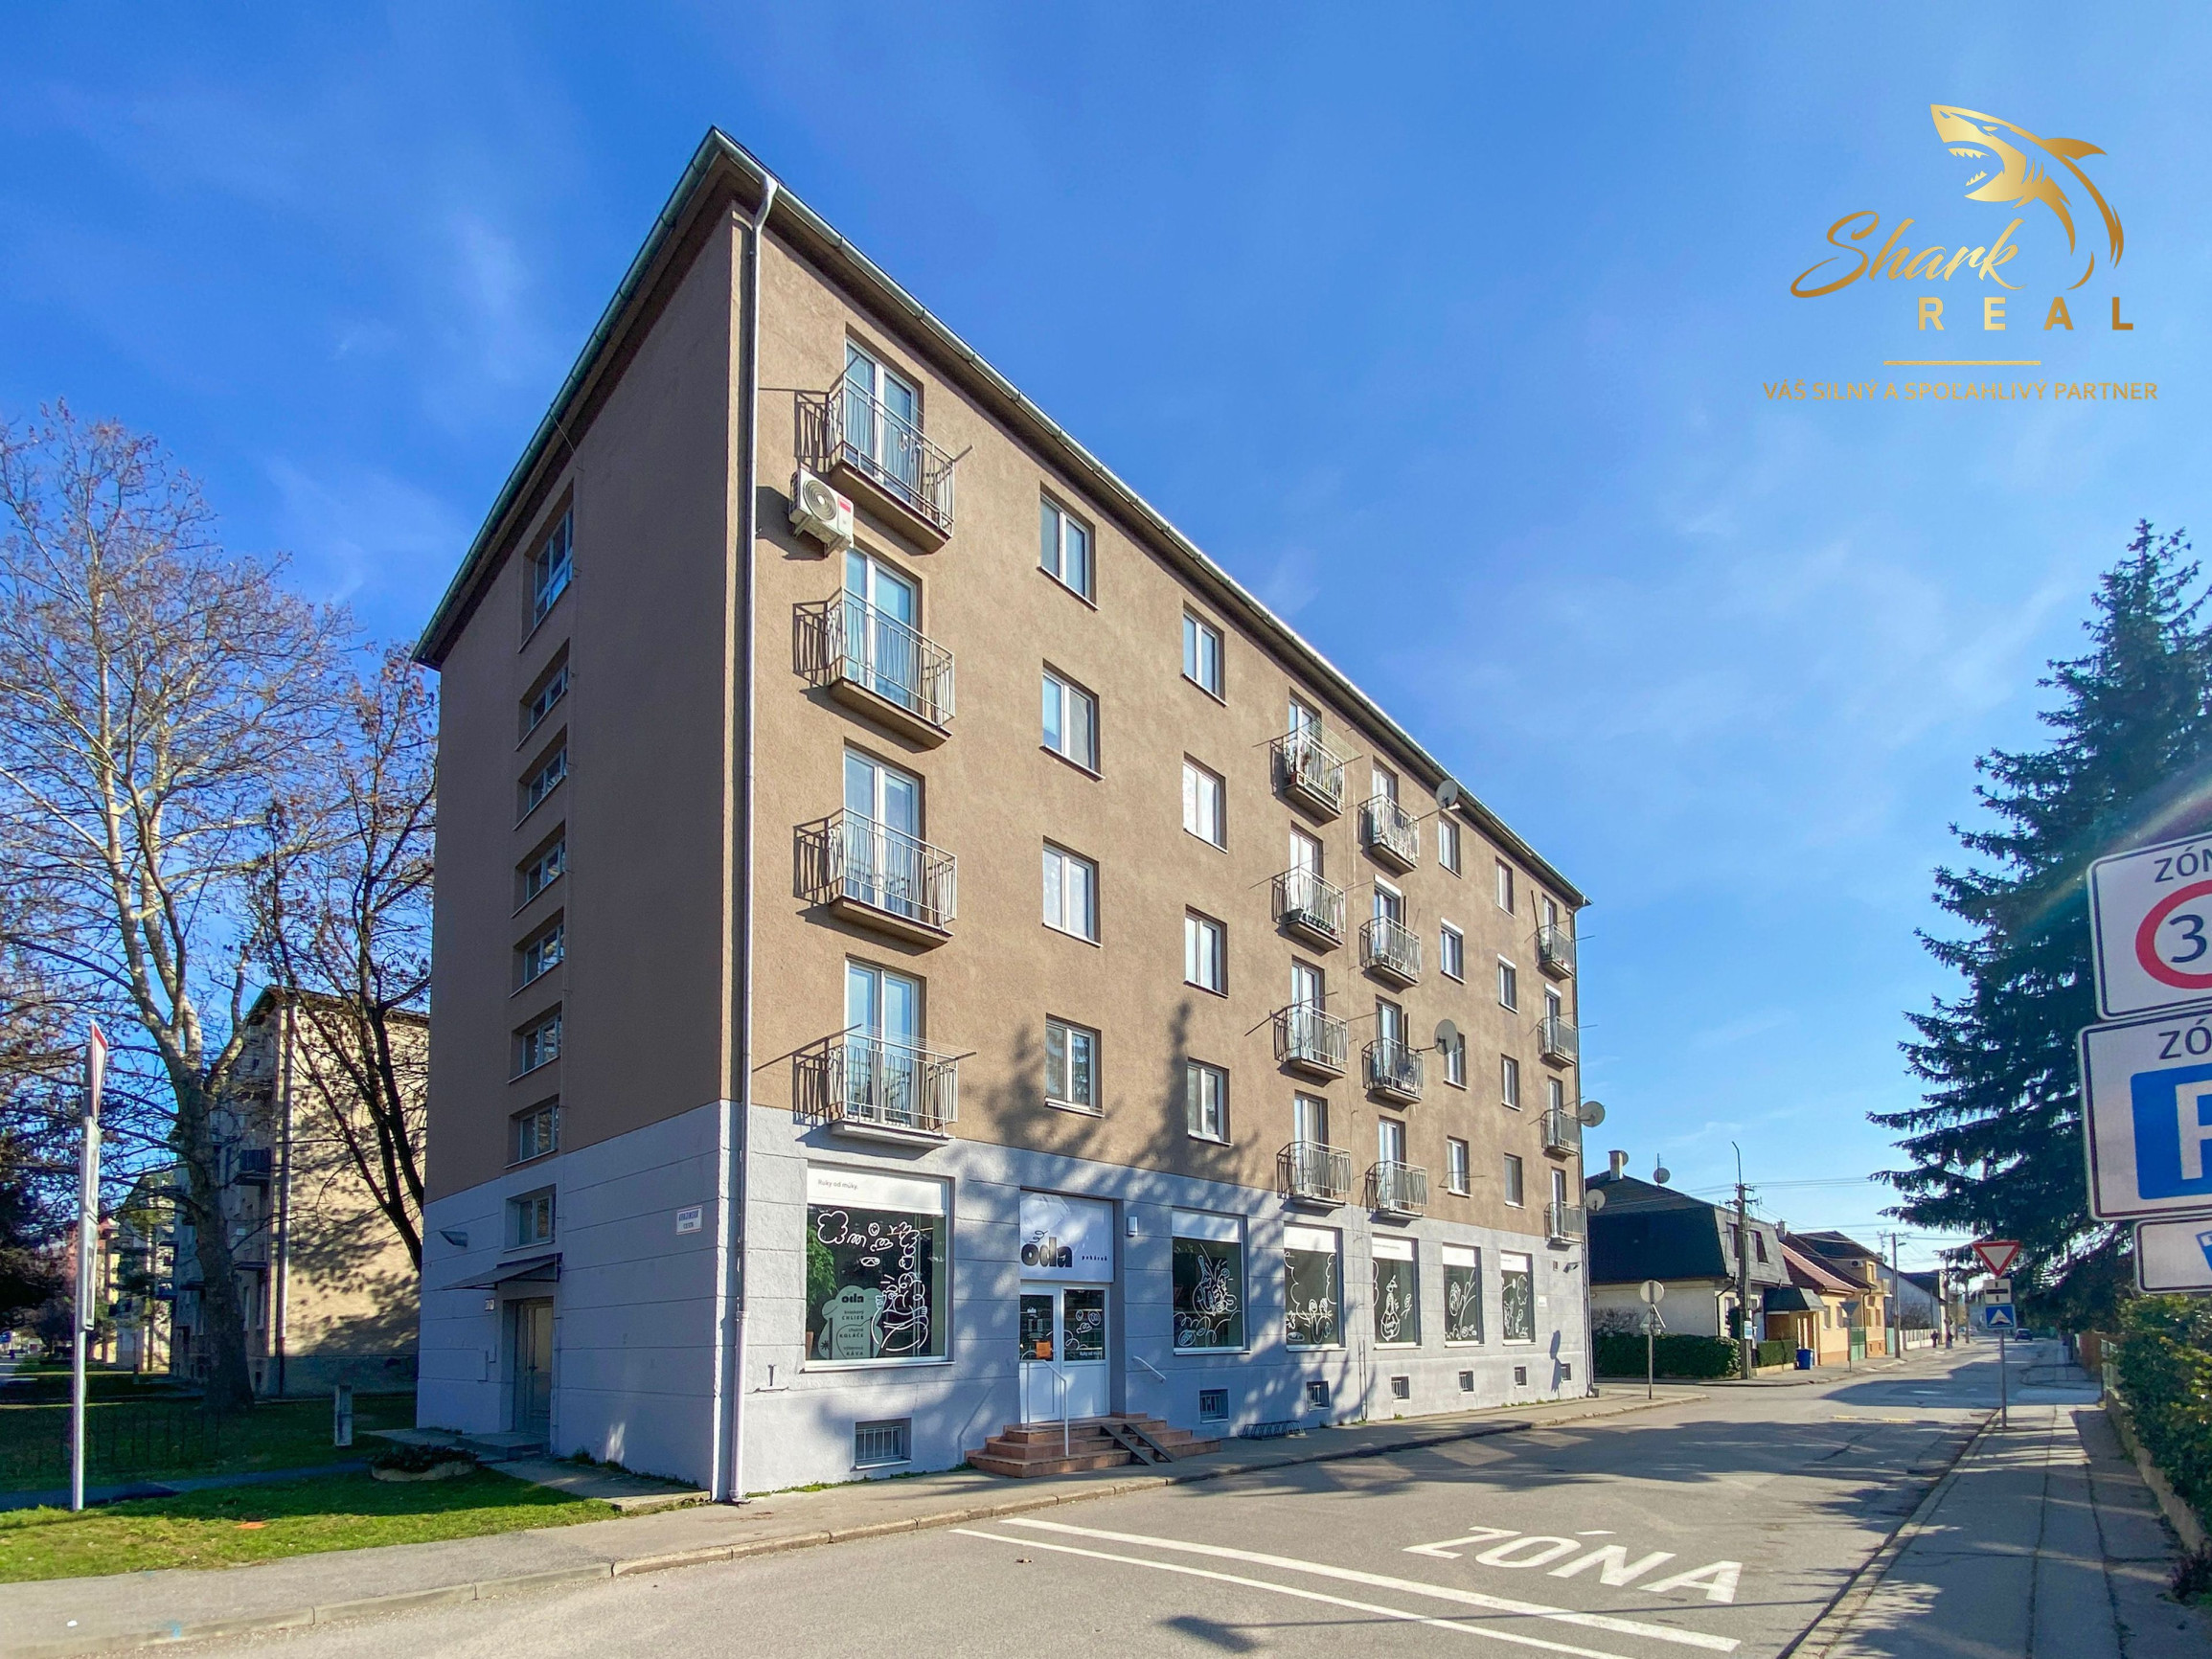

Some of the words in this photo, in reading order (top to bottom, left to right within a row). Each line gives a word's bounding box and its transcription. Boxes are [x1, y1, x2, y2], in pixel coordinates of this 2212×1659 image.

[1021, 1236, 1073, 1268] oda
[841, 1293, 864, 1304] oda
[1402, 1526, 1743, 1603] ZÓNA
